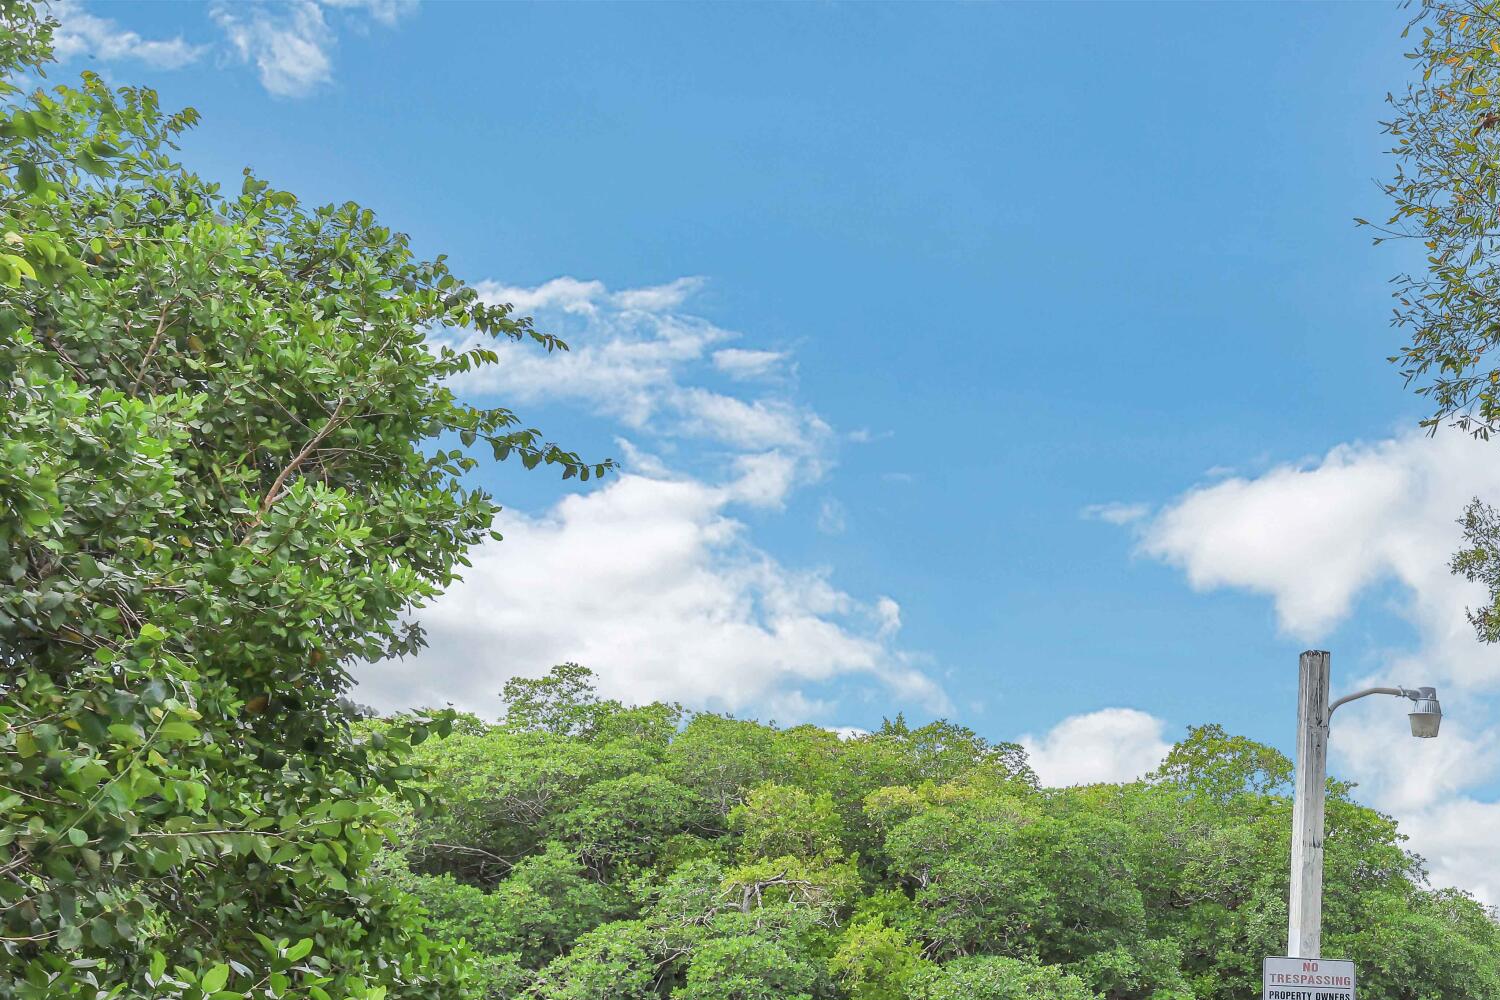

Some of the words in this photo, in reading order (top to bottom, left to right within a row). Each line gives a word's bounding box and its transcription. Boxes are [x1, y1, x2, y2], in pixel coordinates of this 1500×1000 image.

[1303, 963, 1318, 972] NO
[1270, 974, 1350, 985] TRESPASSING
[1269, 991, 1312, 1000] PROPERTY
